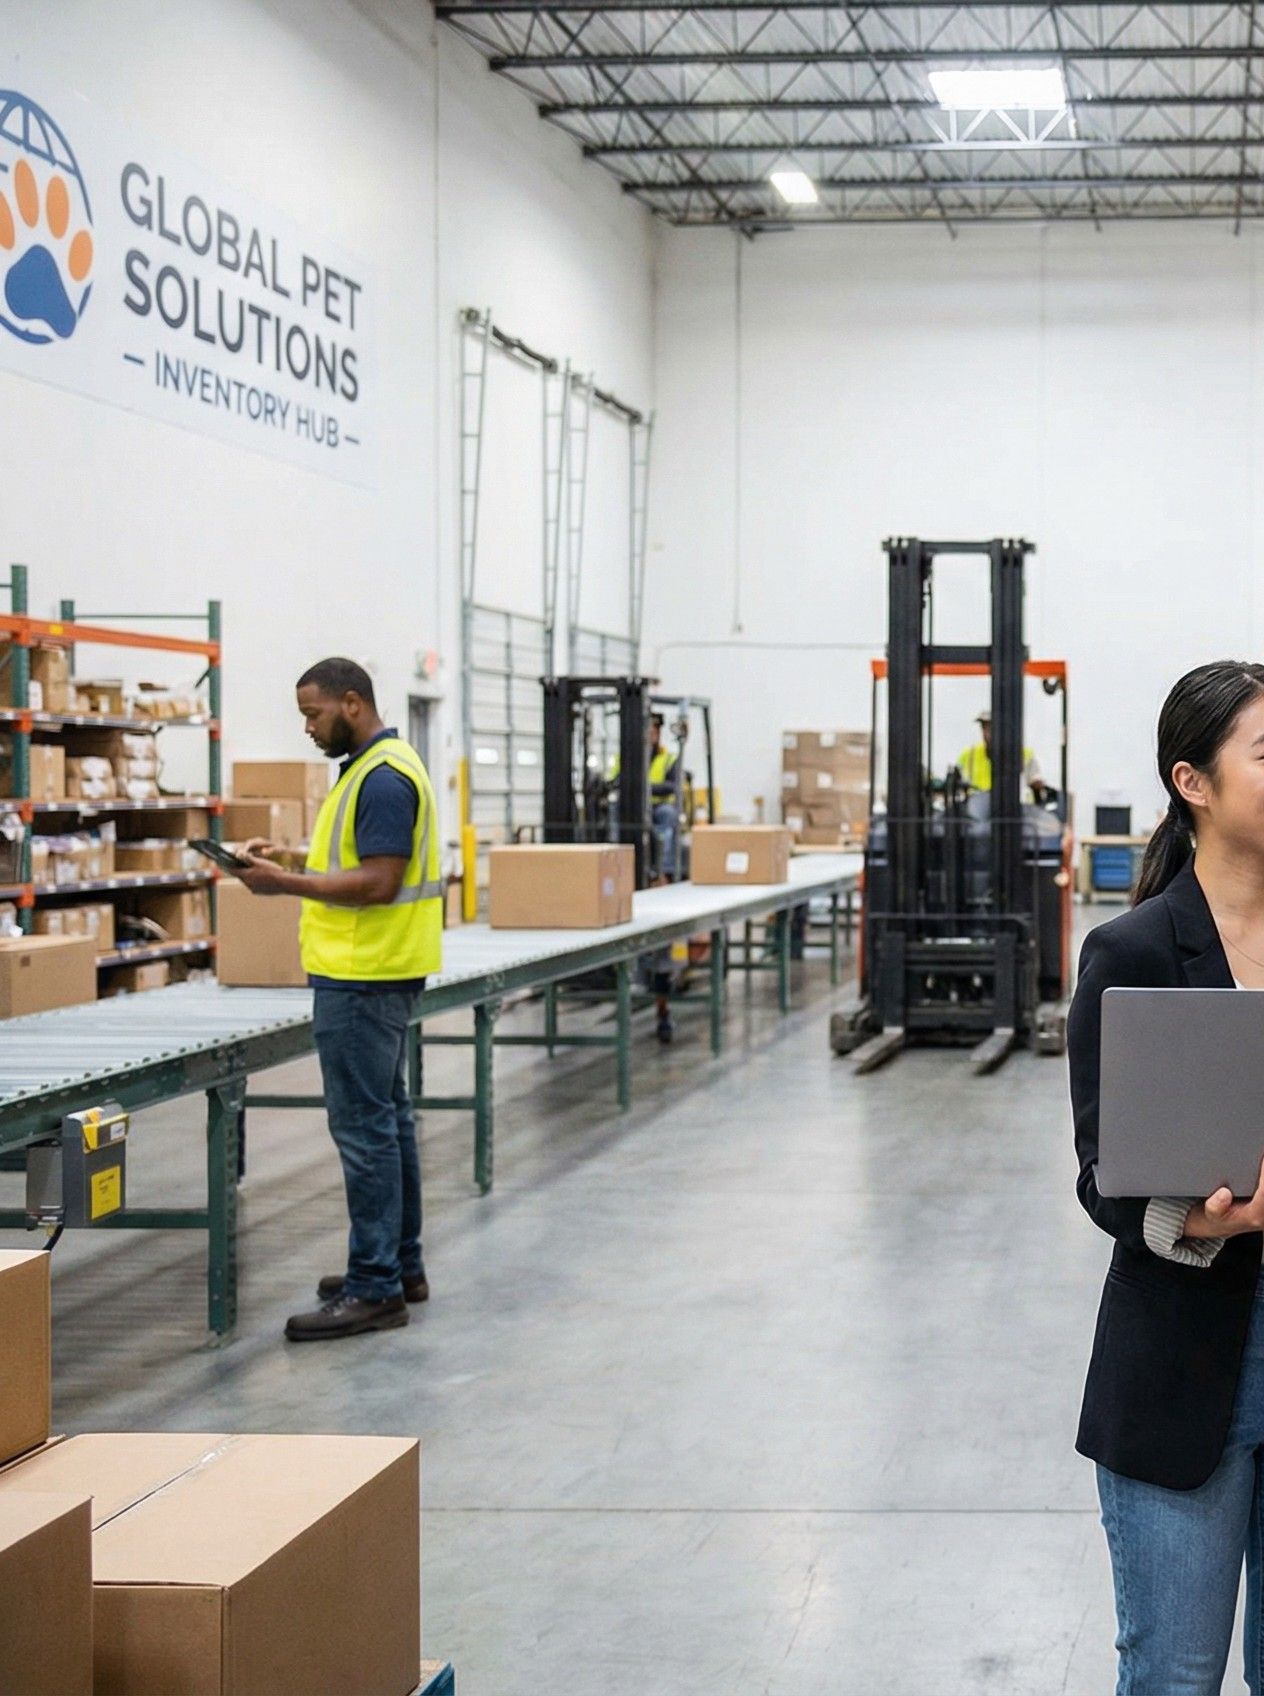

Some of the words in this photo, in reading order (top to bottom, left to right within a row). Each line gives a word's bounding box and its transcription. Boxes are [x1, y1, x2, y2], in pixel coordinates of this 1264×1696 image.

[120, 161, 292, 299] GLOBAL
[302, 255, 362, 330] PET
[123, 249, 359, 402] SOLUTIONS
[156, 352, 291, 430] INVENTORY
[296, 407, 340, 448] HUB
